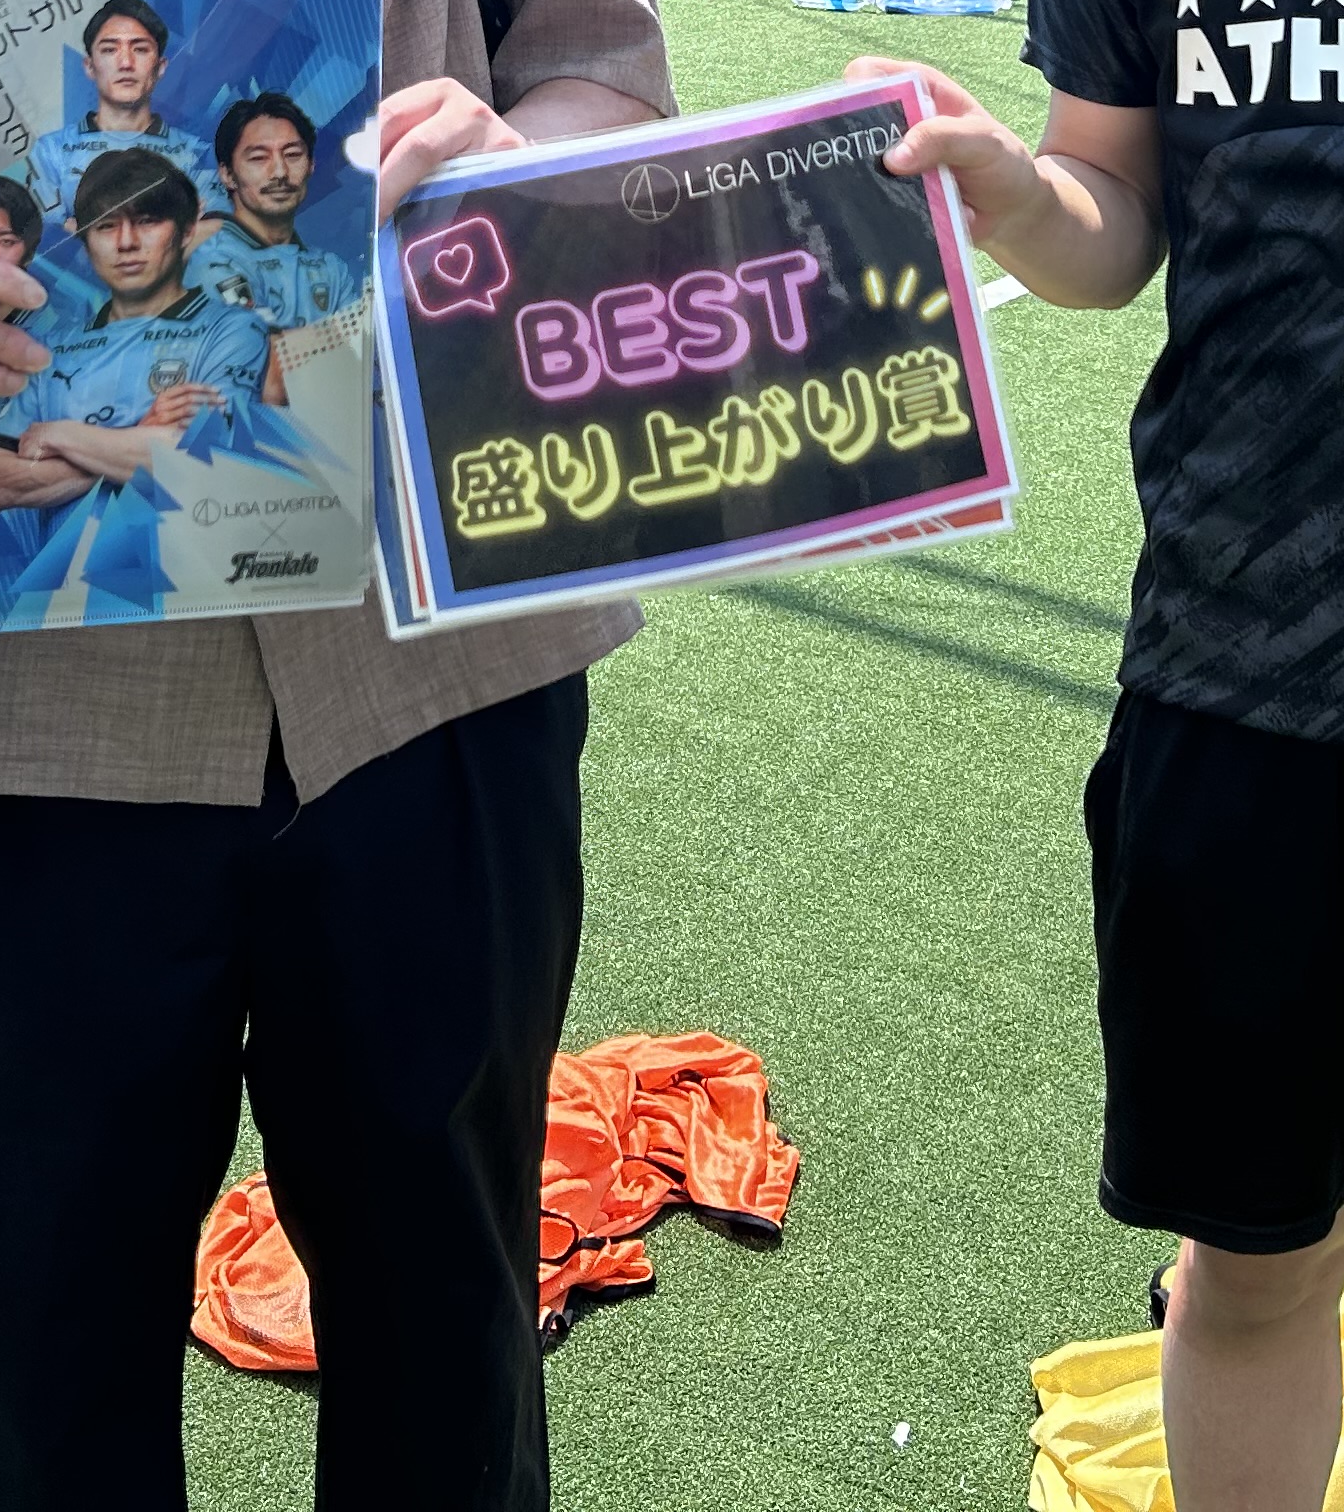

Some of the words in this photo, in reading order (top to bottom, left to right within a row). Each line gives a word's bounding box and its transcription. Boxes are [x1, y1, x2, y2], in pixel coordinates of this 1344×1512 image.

[516, 249, 819, 400] BEST
[453, 346, 971, 538] 盛り上がり賞
